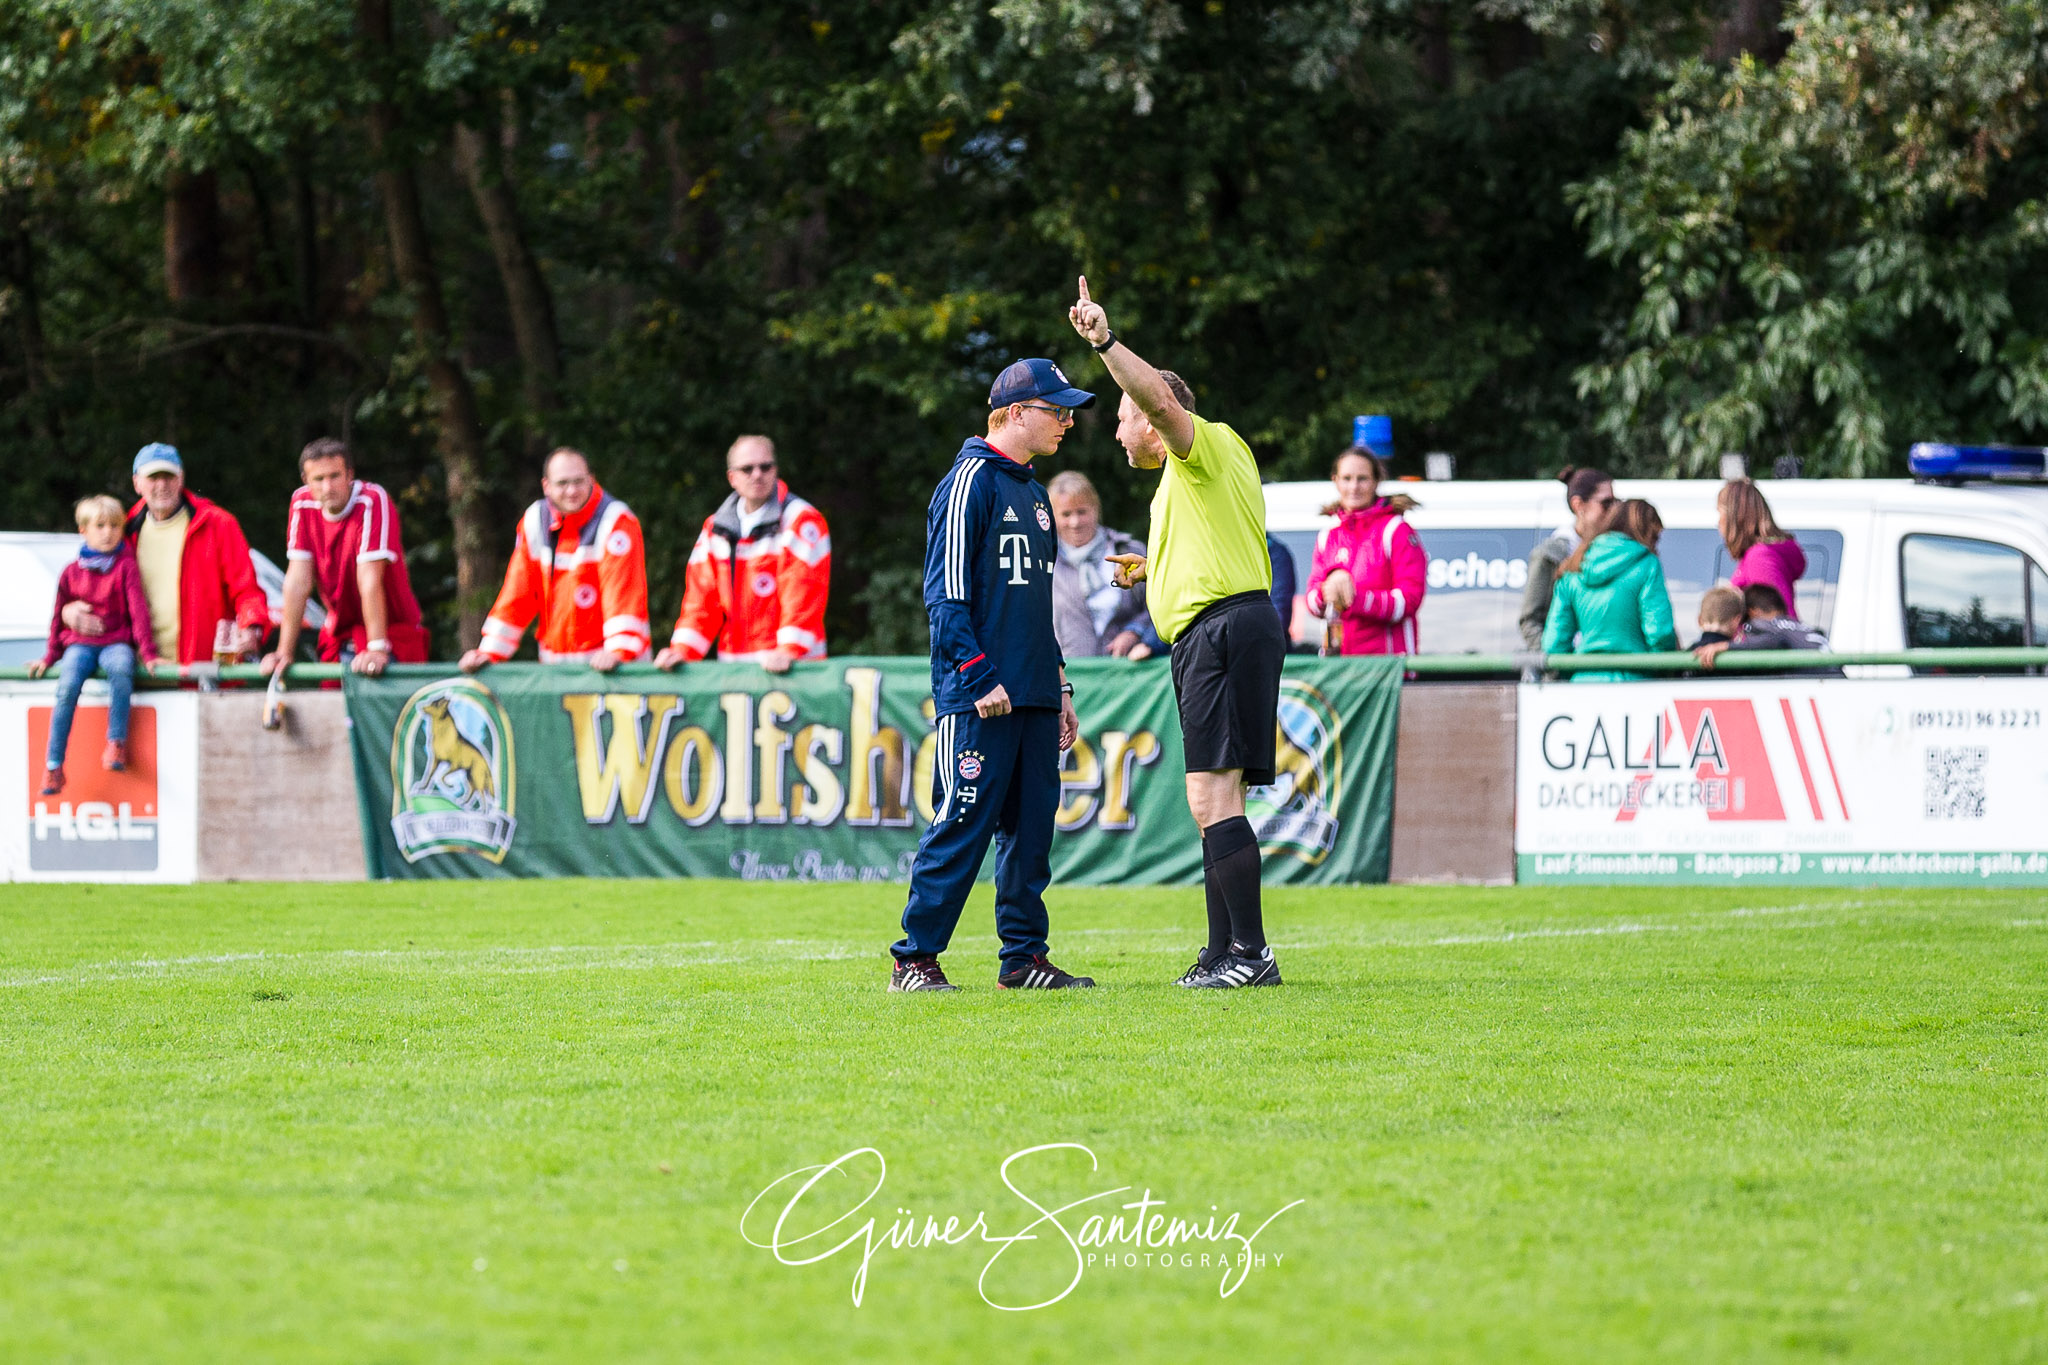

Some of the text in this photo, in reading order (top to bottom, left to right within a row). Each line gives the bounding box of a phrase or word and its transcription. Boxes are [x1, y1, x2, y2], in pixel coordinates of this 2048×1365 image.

[1425, 551, 1528, 589] sches
[2022, 708, 2041, 729] 21
[563, 668, 1160, 832] Wolfsher
[1542, 714, 1724, 771] GALLA
[1538, 782, 1728, 810] DACHDECKEREI
[1535, 852, 2047, 879] Lauf-Simonshofen Bachgasse 20 www.dachdeckerei-galla.de
